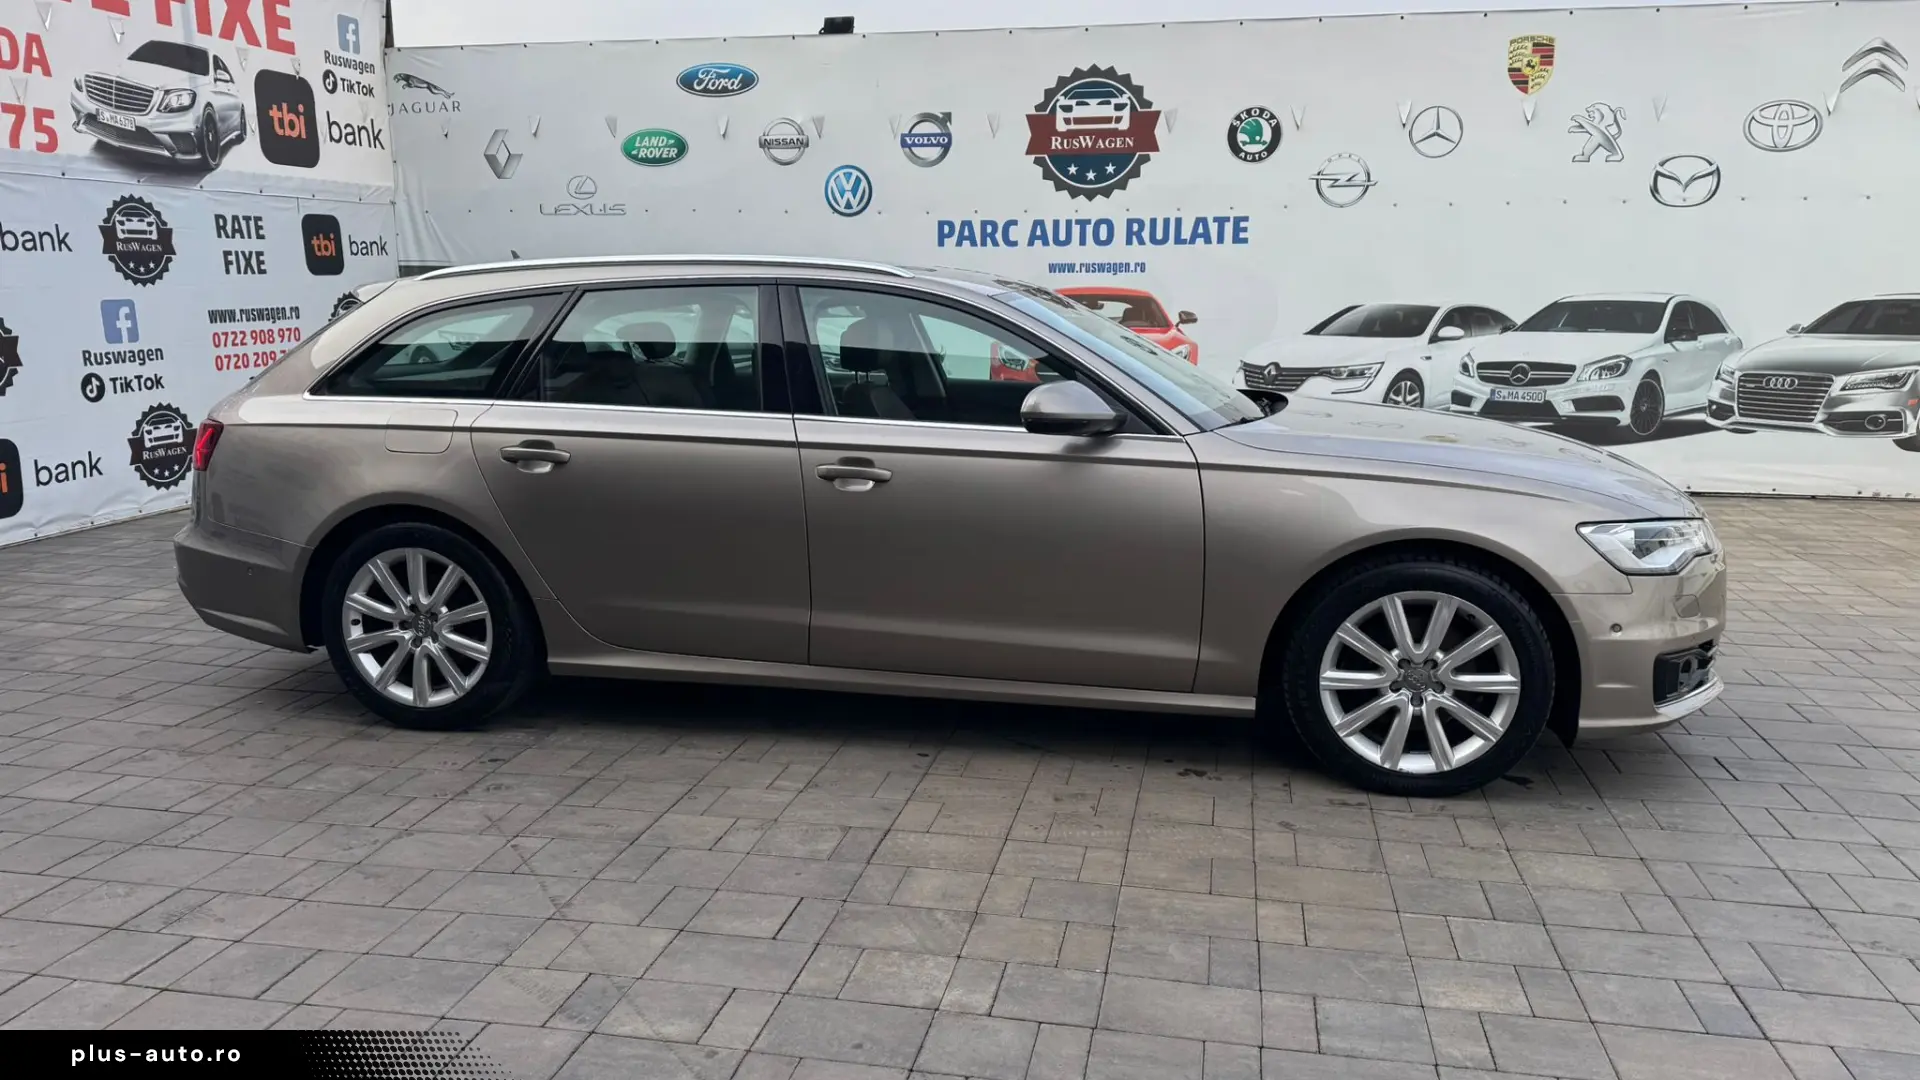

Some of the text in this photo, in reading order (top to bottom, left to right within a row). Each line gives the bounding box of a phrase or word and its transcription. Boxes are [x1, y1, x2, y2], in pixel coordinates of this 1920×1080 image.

[324, 50, 375, 74] Ruswagen
[340, 78, 375, 98] TikTok
[693, 67, 743, 92] Ford
[389, 100, 461, 117] JAGUAR
[1, 102, 59, 153] 75
[269, 103, 385, 150] tbi bank
[634, 136, 667, 147] LAND
[763, 137, 804, 147] NISSAN
[904, 135, 949, 145] VOLVO
[638, 147, 678, 158] ROVER
[1239, 151, 1267, 160] AUTO
[539, 203, 628, 216] LEXUS
[0, 221, 73, 252] bank
[214, 213, 266, 240] RATE
[938, 216, 1249, 247] PARC AUTO RULATE
[311, 233, 389, 256] tbi bank
[222, 249, 267, 275] FIXE
[1048, 260, 1146, 276] www.ruswagen.ro
[208, 306, 300, 324] www.ruswagen.ro
[212, 327, 301, 348] 0722 908 970
[82, 347, 164, 368] Ruswagen
[215, 352, 250, 371] 0720
[109, 374, 165, 395] TikTok
[34, 451, 103, 486] bank
